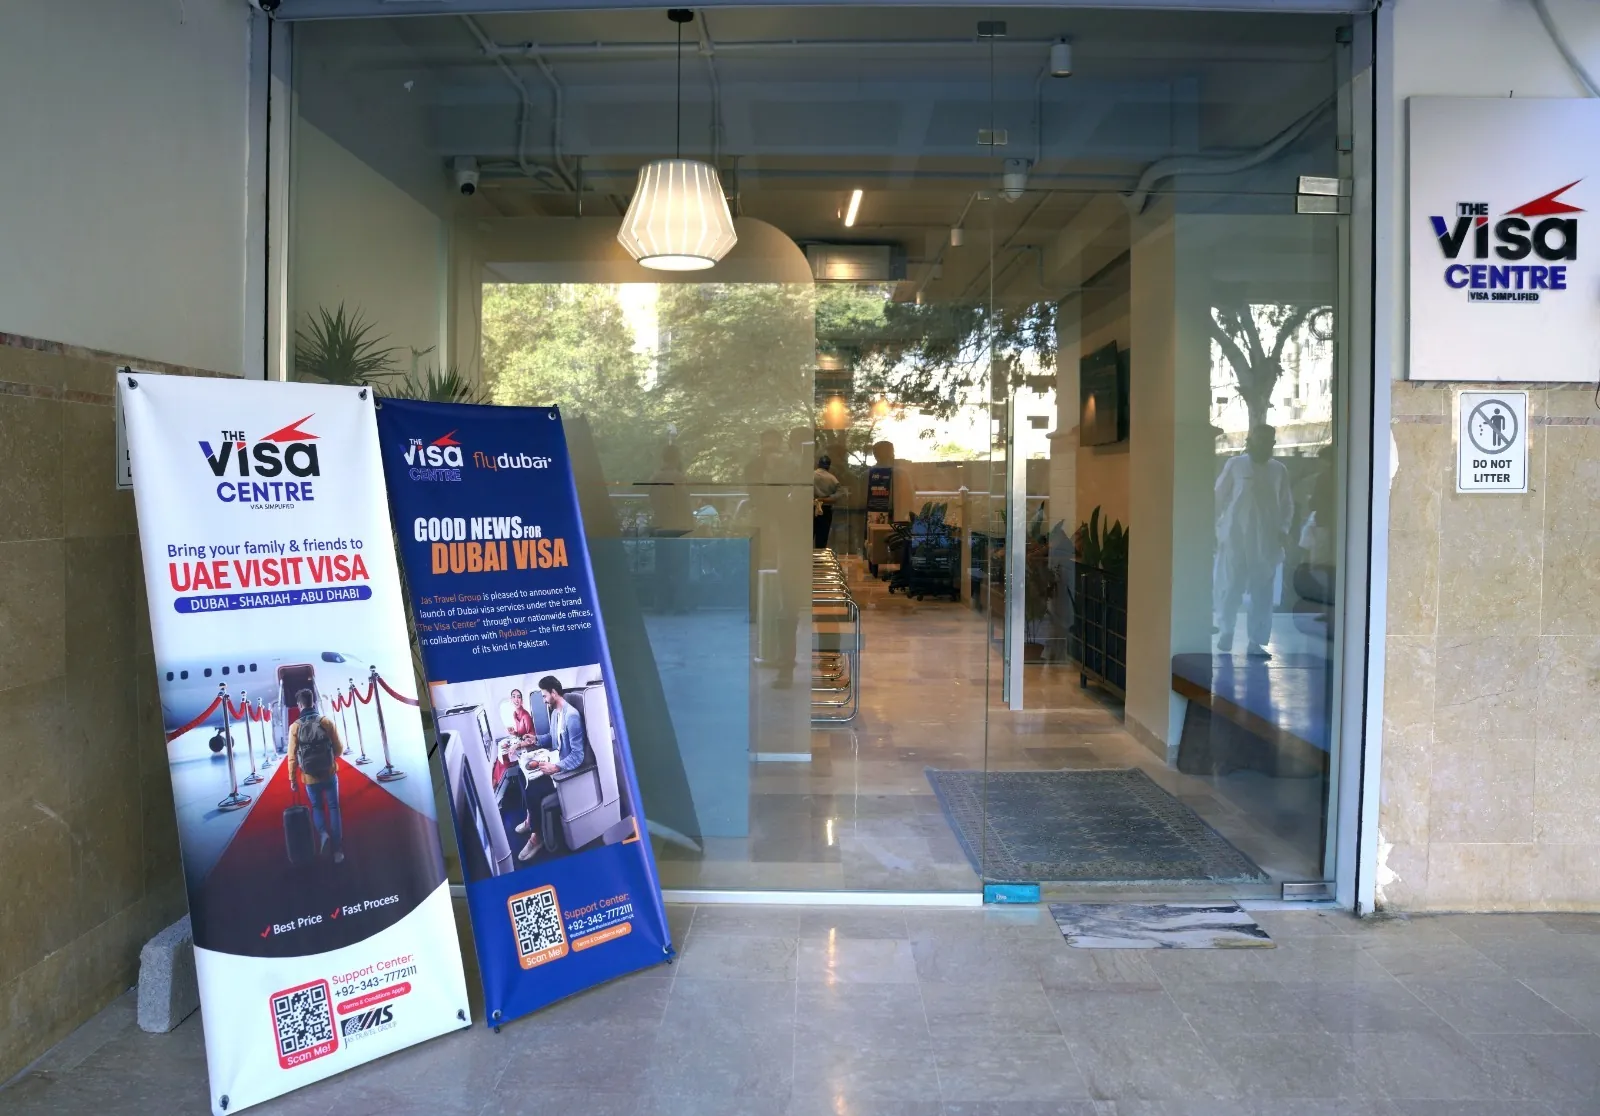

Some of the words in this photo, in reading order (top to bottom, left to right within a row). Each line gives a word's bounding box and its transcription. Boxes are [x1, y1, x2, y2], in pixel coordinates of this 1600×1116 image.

[1458, 202, 1489, 216] THE
[1444, 263, 1567, 290] CENTRE
[1470, 291, 1489, 301] VISA
[1491, 291, 1540, 302] SIMPLIFIED
[221, 430, 246, 441] THE
[472, 451, 550, 472] flydubai
[1472, 459, 1487, 469] DO
[1490, 459, 1512, 469] NOT
[408, 467, 462, 481] CENTRE
[1473, 473, 1511, 483] LITTER
[216, 481, 315, 503] CENTRE
[414, 516, 466, 542] GOOD
[470, 515, 523, 541] NEWS
[523, 525, 542, 539] FOR
[167, 543, 206, 559] Bring
[209, 544, 241, 559] your
[243, 540, 285, 556] family
[289, 539, 301, 552] &
[303, 537, 348, 552] friends
[349, 538, 363, 549] to
[431, 540, 508, 575] DUBAI
[512, 538, 569, 570] VISA
[168, 560, 232, 592] UAE
[232, 556, 304, 588] VISIT
[306, 554, 370, 583] VISA
[190, 597, 229, 611] DUBAI
[239, 593, 291, 607] SHARJAH
[300, 590, 324, 603] ABU
[326, 588, 360, 601] DHABI
[433, 593, 457, 604] Travel
[458, 593, 481, 602] Group
[482, 592, 489, 601] is
[490, 589, 519, 602] pleased
[519, 590, 528, 598] to
[529, 587, 564, 597] announce
[564, 585, 577, 594] the
[419, 608, 446, 619] launch
[447, 607, 456, 617] of
[456, 606, 479, 616] Dubai
[479, 605, 495, 614] visa
[496, 602, 525, 613] services
[526, 601, 548, 610] under
[548, 599, 561, 608] the
[561, 597, 582, 607] brand
[433, 622, 451, 631] Visa
[482, 615, 513, 627] through
[513, 616, 526, 624] our
[527, 611, 567, 622] nationwide
[567, 609, 594, 618] offices,
[421, 637, 429, 646] in
[429, 634, 480, 645] collaboration
[480, 631, 498, 640] with
[498, 628, 528, 640] flydubai
[538, 625, 551, 634] the
[552, 624, 565, 633] first
[566, 621, 592, 631] service
[472, 645, 481, 655] of
[481, 645, 491, 654] its
[491, 642, 509, 653] kind
[509, 642, 517, 651] in
[517, 639, 550, 649] Pakistan.
[342, 903, 362, 916] Fast
[363, 893, 399, 911] Process
[564, 901, 599, 920] Support
[599, 893, 630, 908] Center:
[273, 920, 296, 935] Best
[297, 913, 323, 928] Price
[567, 903, 633, 931] +92-343-7772111
[526, 952, 548, 967] Scan
[548, 947, 564, 959] Me!
[331, 964, 373, 985] Support
[376, 953, 415, 971] Center:
[334, 965, 417, 998] +92-343-7772111
[342, 1001, 359, 1010] Terms
[364, 992, 391, 1004] Conditions
[391, 986, 406, 994] Apply
[287, 1049, 312, 1066] Scan
[313, 1043, 332, 1057] Me!
